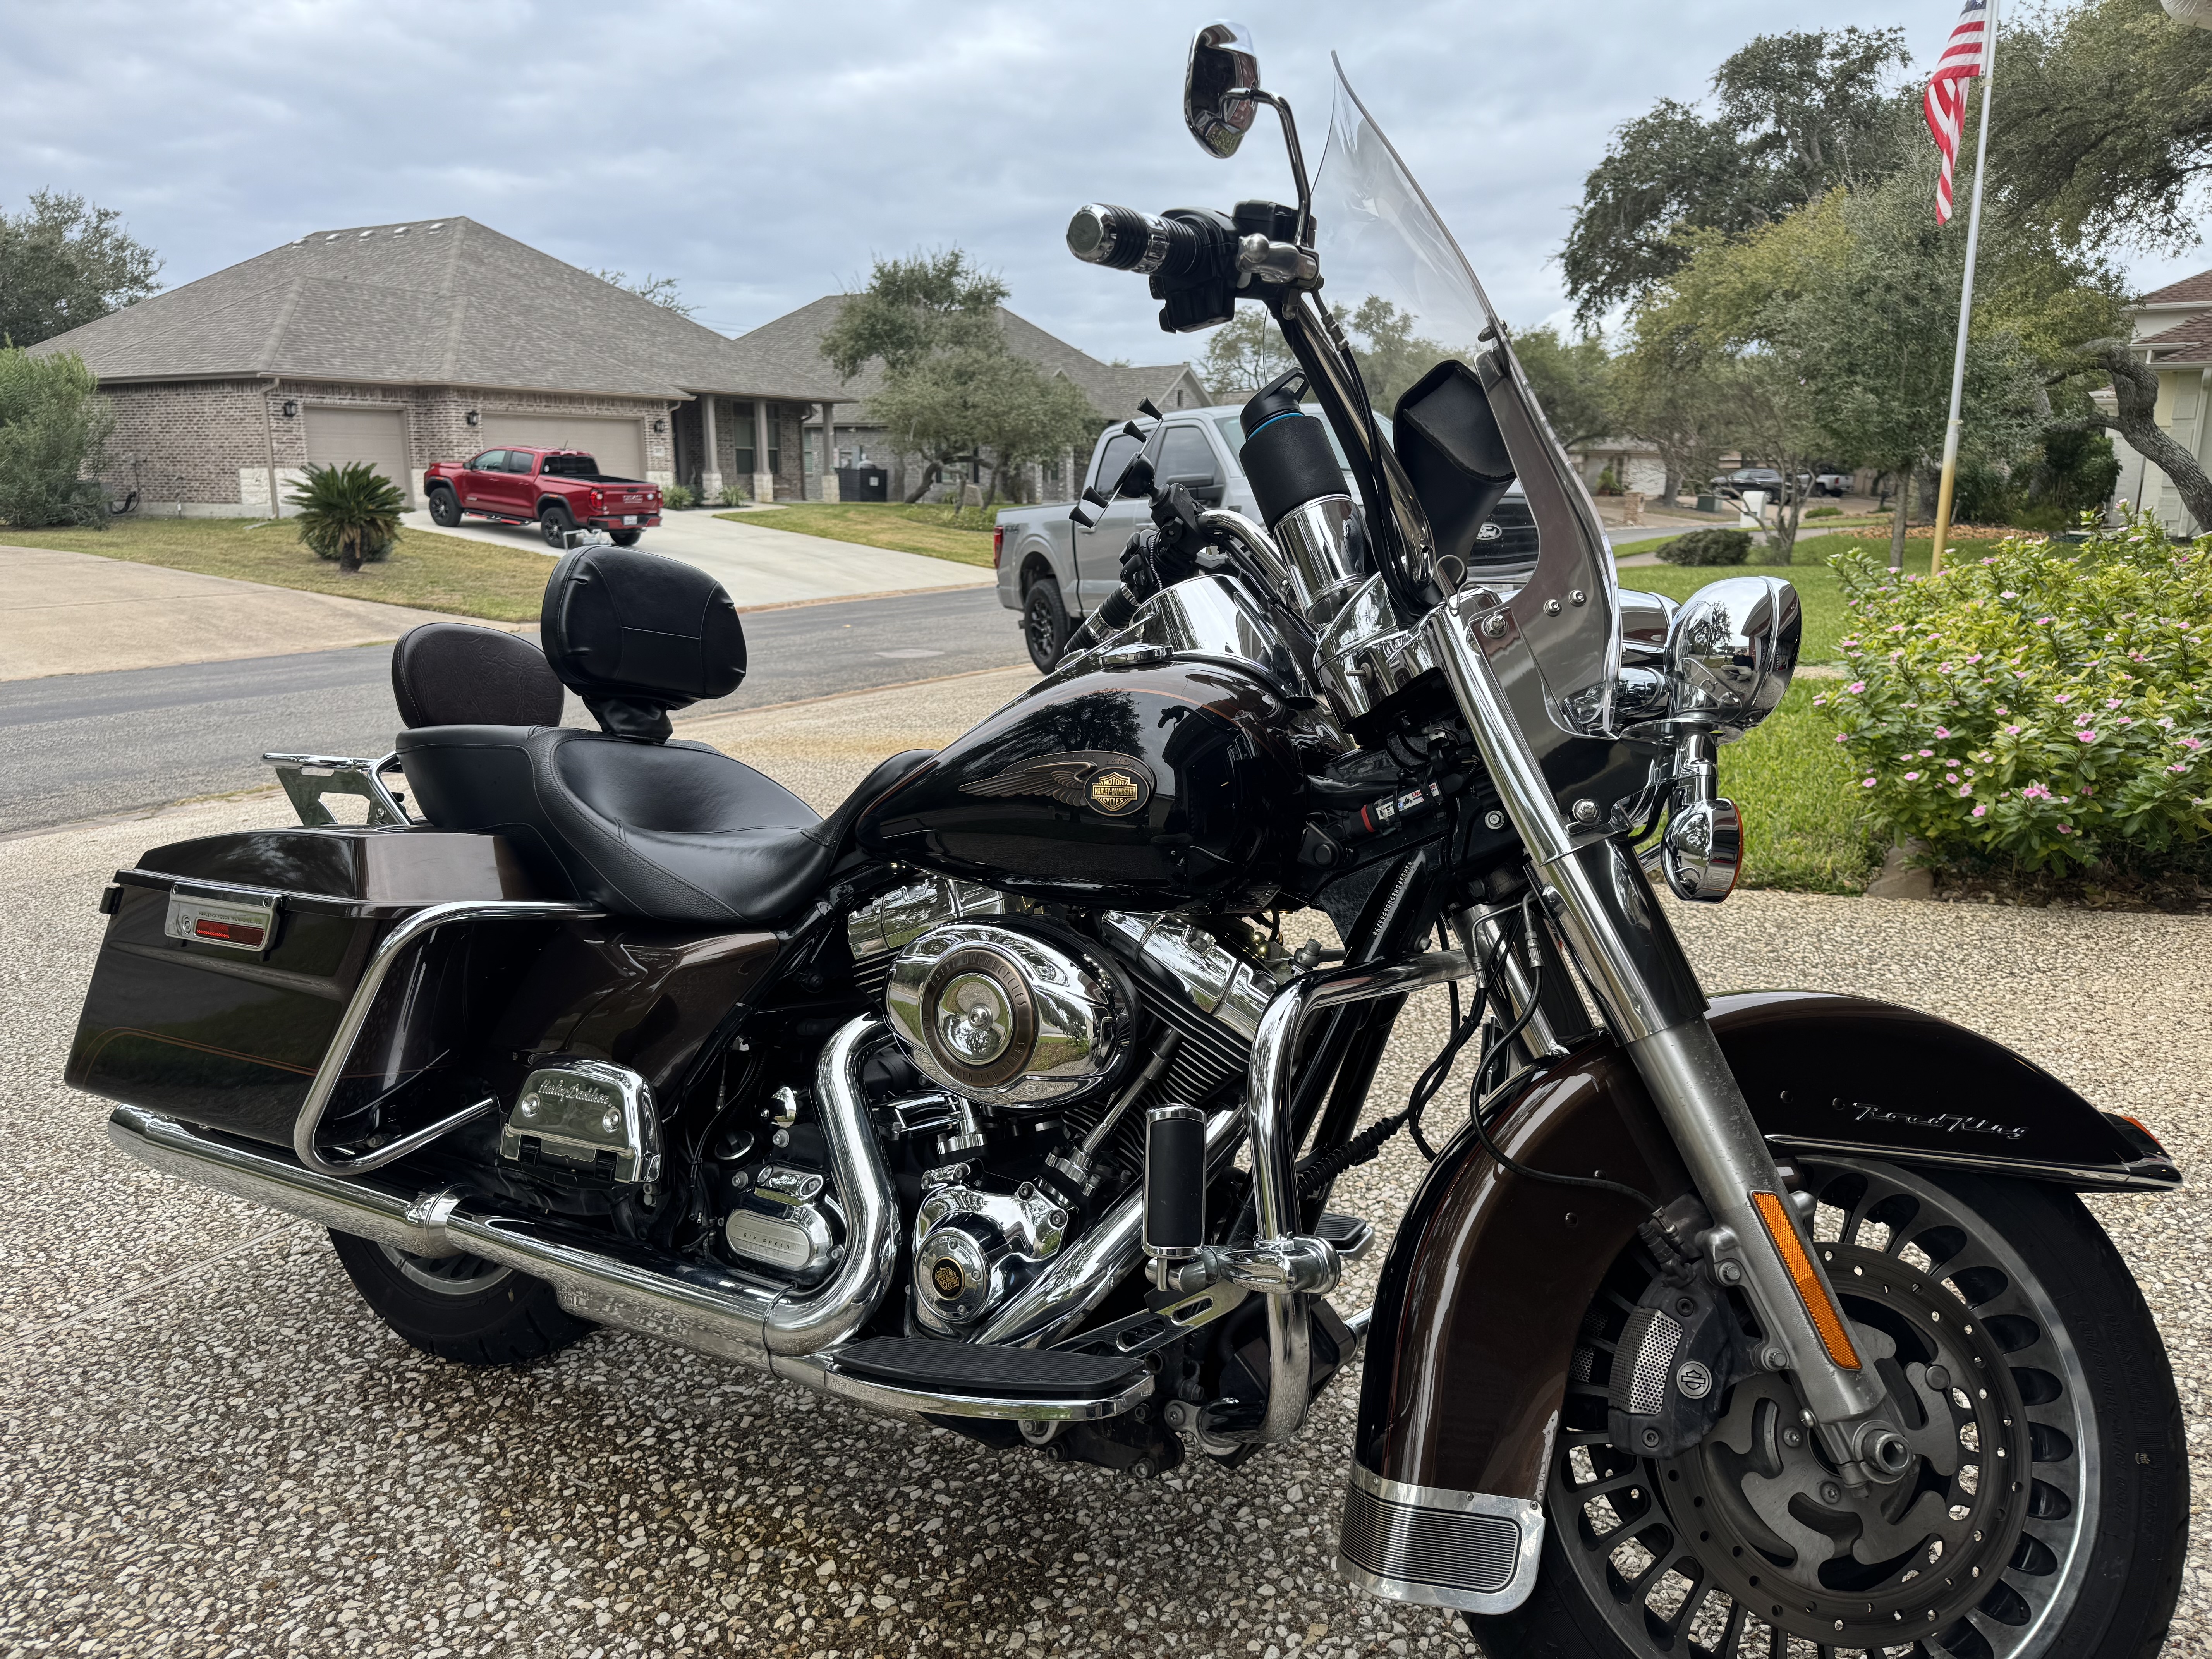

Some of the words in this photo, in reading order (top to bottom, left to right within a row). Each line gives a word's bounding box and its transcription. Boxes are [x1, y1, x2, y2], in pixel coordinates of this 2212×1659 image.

[1103, 777, 1124, 785] MOTOR
[1094, 787, 1133, 796] HARLEY-DAVIDSON
[1103, 797, 1123, 807] CYCLES
[963, 953, 1027, 1006] MOTORCYCLES
[763, 1238, 790, 1249] SPEED
